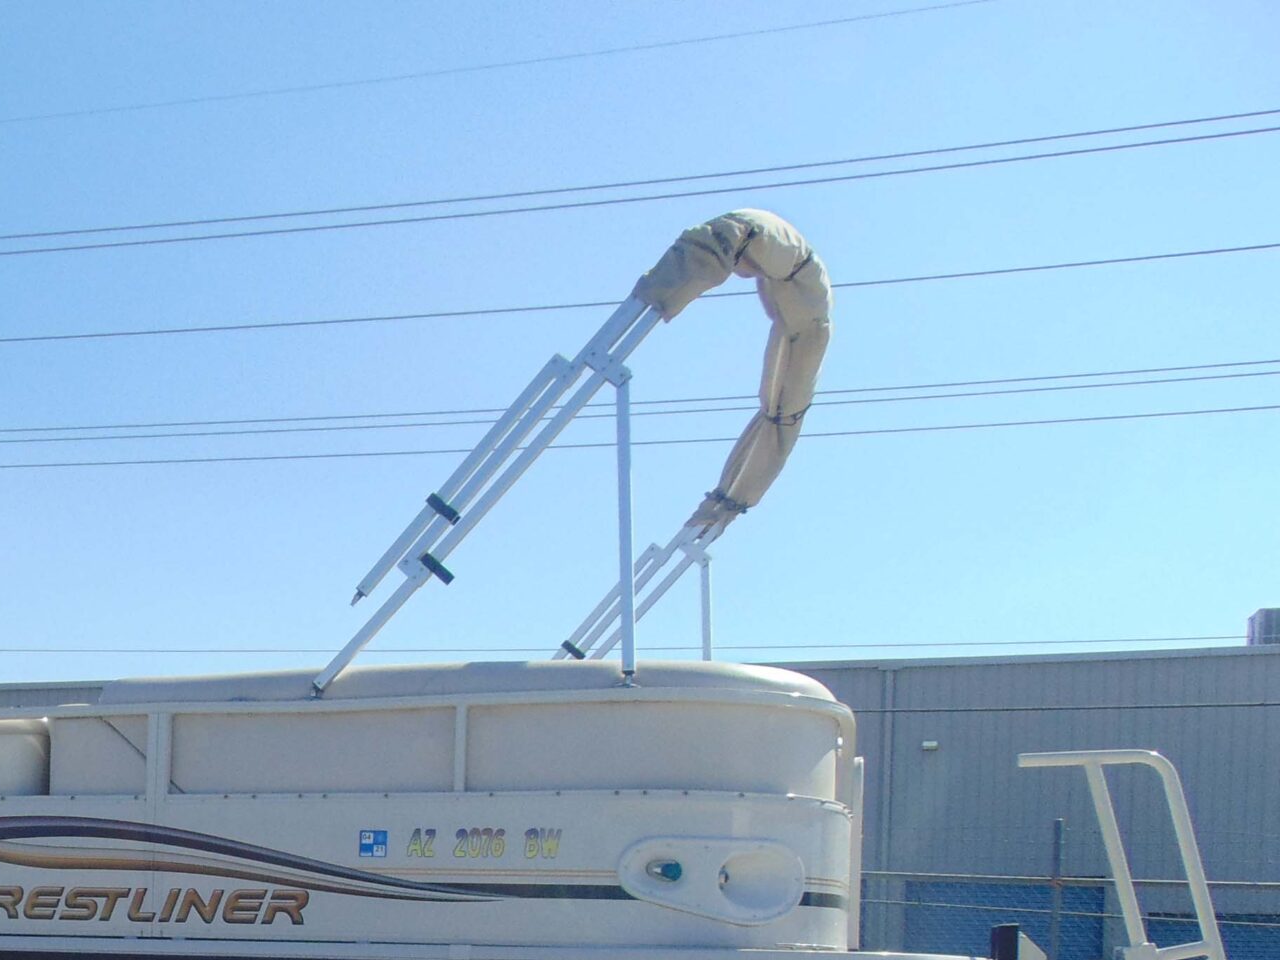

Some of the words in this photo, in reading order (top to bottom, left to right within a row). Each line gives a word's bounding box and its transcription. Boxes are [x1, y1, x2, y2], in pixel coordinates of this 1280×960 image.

[407, 828, 437, 857] AZ
[453, 827, 506, 858] 2076
[524, 828, 562, 859] BW
